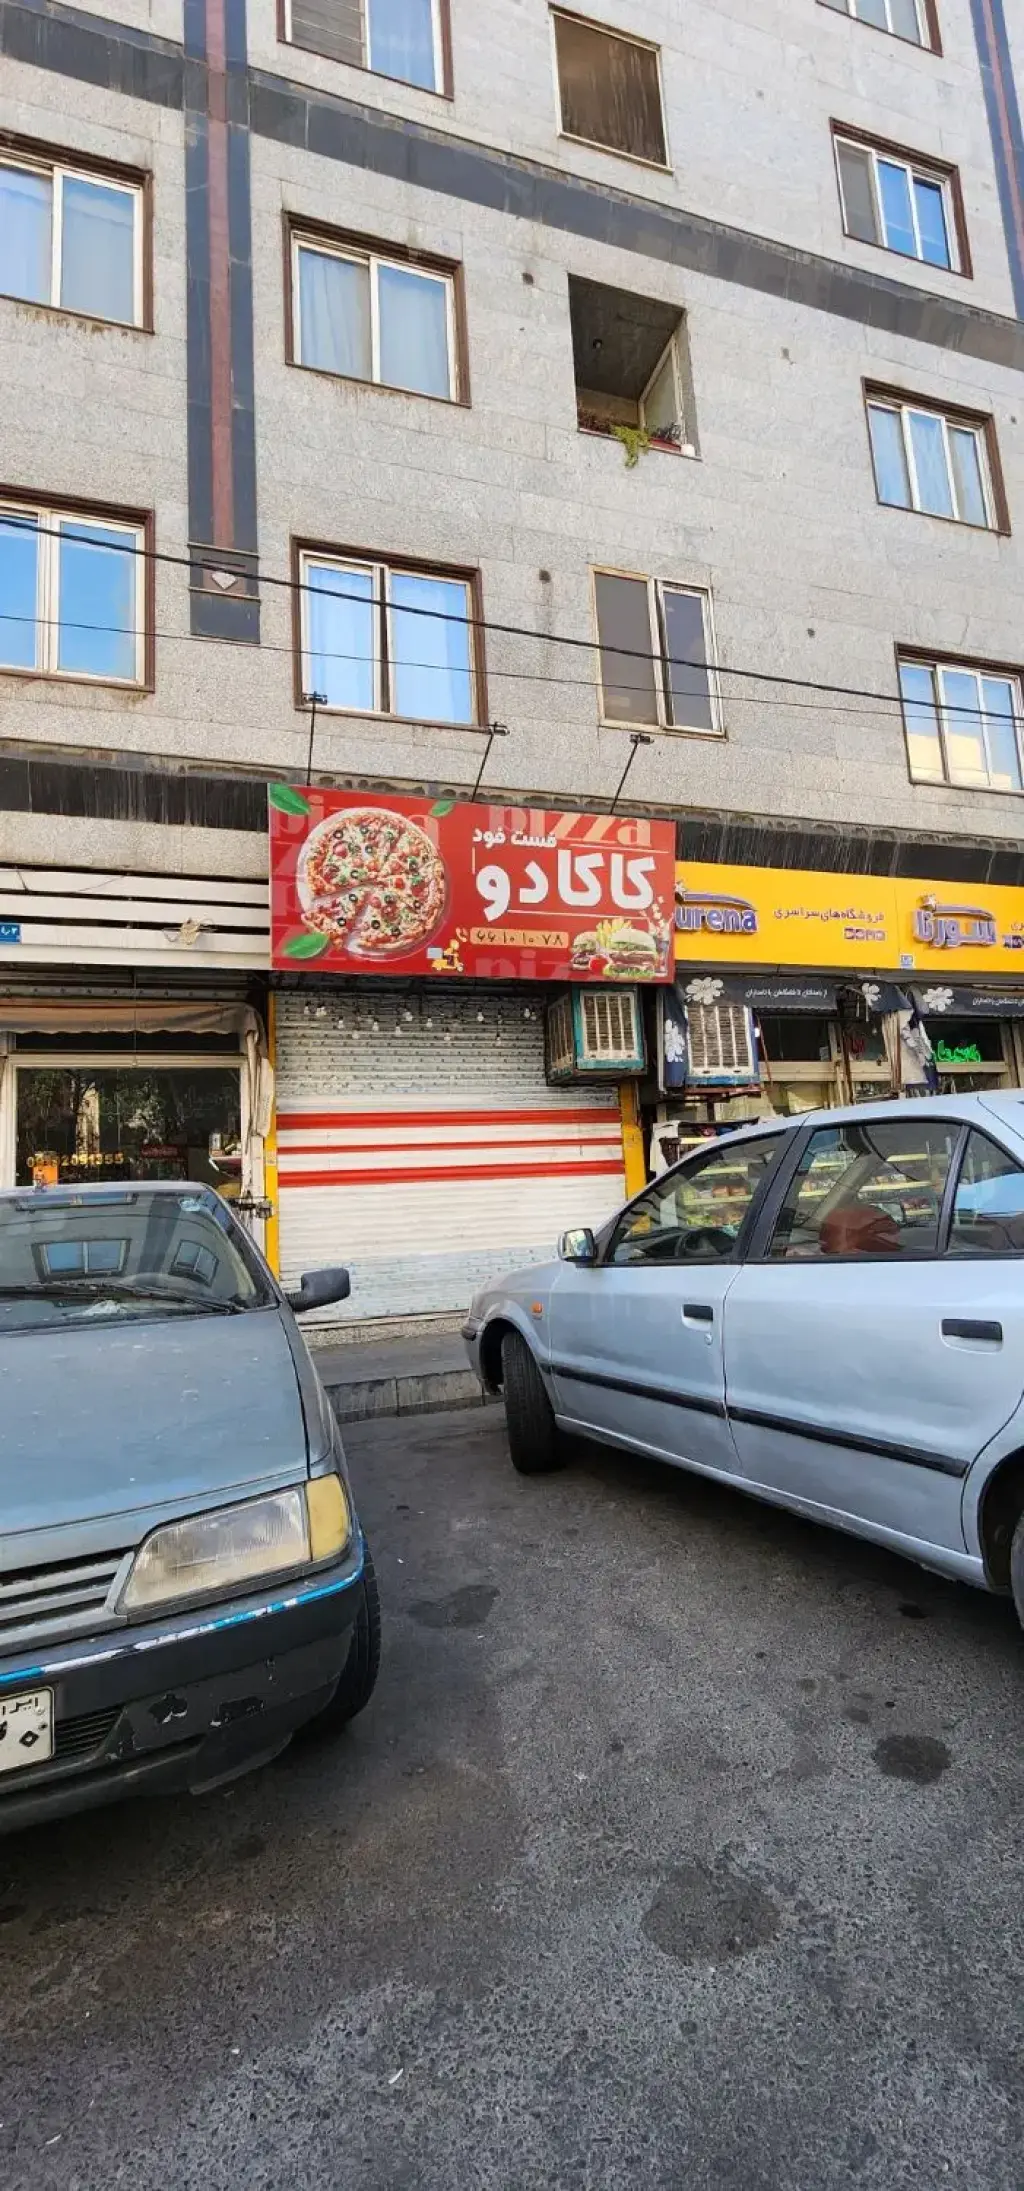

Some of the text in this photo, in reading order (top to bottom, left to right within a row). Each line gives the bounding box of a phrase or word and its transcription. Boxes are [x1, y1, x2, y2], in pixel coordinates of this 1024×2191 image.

[472, 826, 557, 849] فست فود
[476, 849, 656, 922] کاکادو
[675, 905, 758, 934] urena
[912, 908, 996, 948] سورنا
[2, 1697, 39, 1716] ایرا
